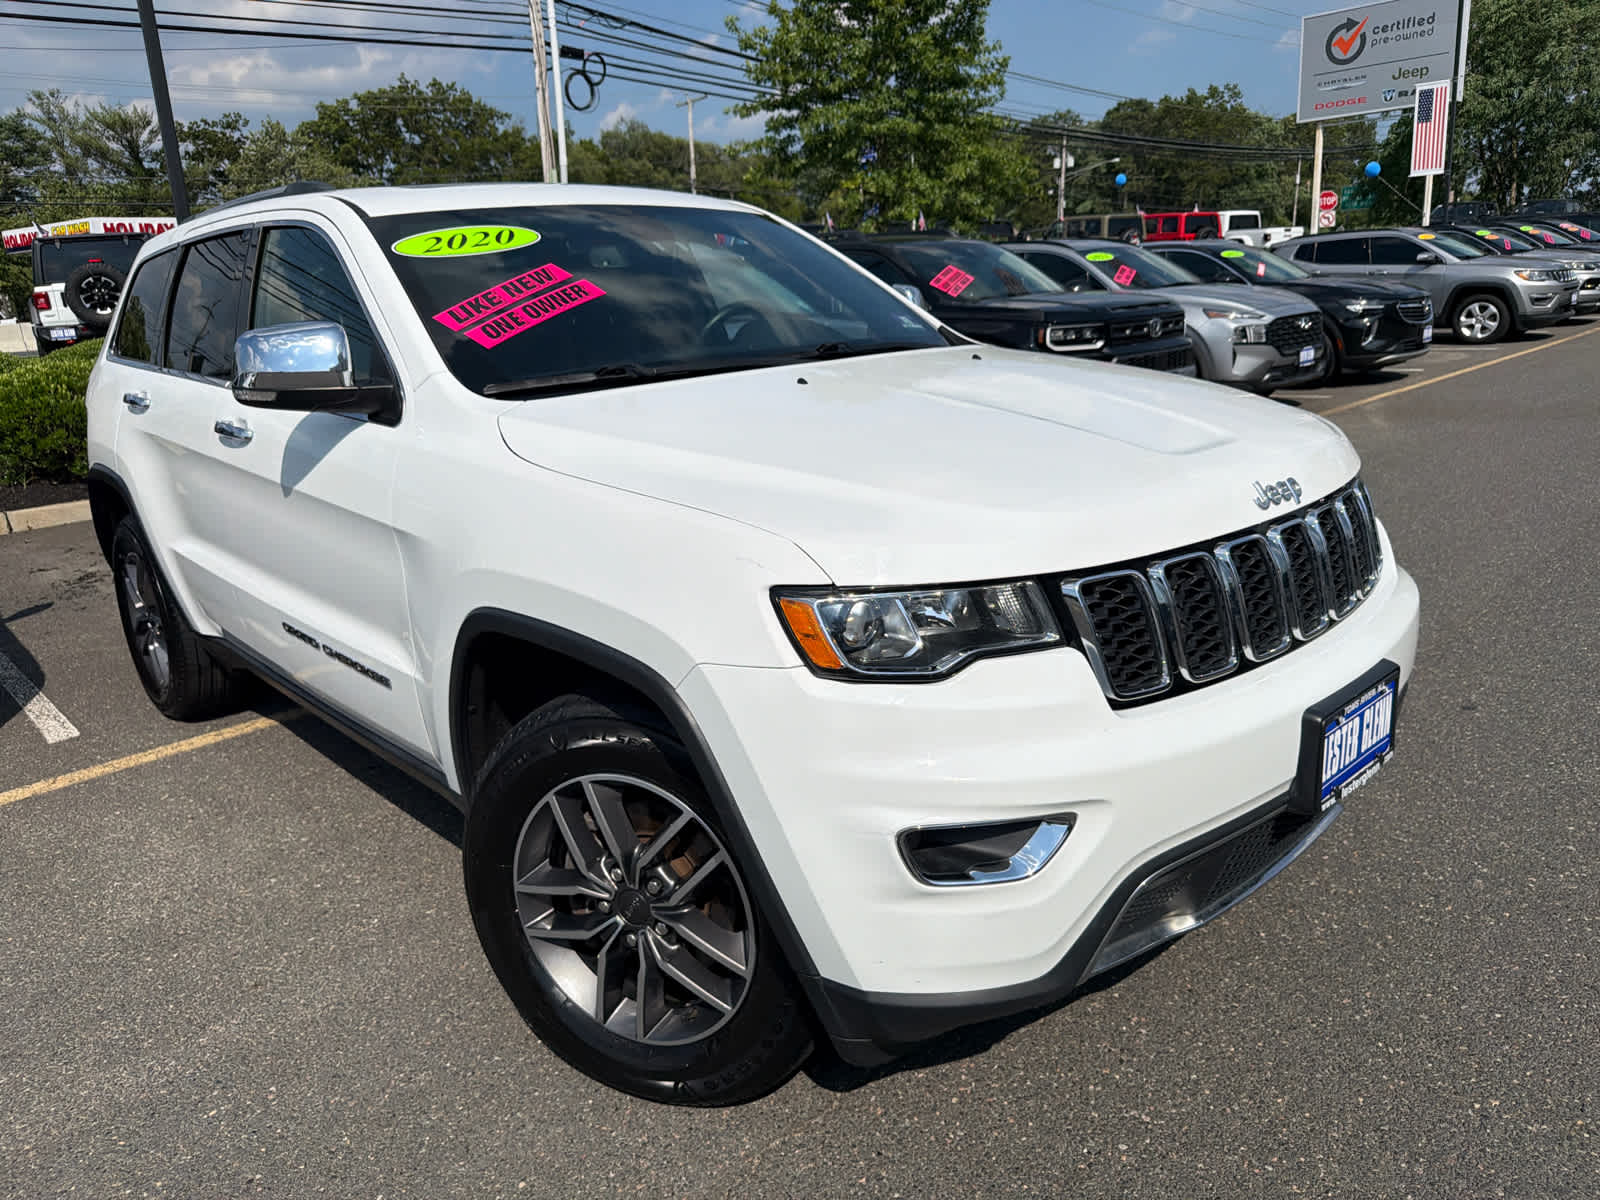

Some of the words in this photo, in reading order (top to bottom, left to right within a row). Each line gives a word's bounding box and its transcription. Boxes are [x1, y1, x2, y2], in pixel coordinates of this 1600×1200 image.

[1372, 12, 1436, 35] certified
[1370, 26, 1435, 48] pre-owned
[1392, 65, 1429, 81] Jeep
[1314, 96, 1368, 111] DODGE
[1319, 196, 1337, 206] STOP
[3, 231, 38, 249] HOLIDAY
[51, 226, 66, 237] CAR
[67, 221, 90, 236] WASH
[423, 229, 515, 254] 2020
[447, 291, 504, 325] LIKE
[502, 266, 556, 299] NEW
[481, 312, 527, 340] ONE
[524, 283, 589, 320] OWNER
[1251, 477, 1302, 511] Jeep
[1322, 715, 1360, 784] LESTER
[1361, 691, 1393, 754] GLENN
